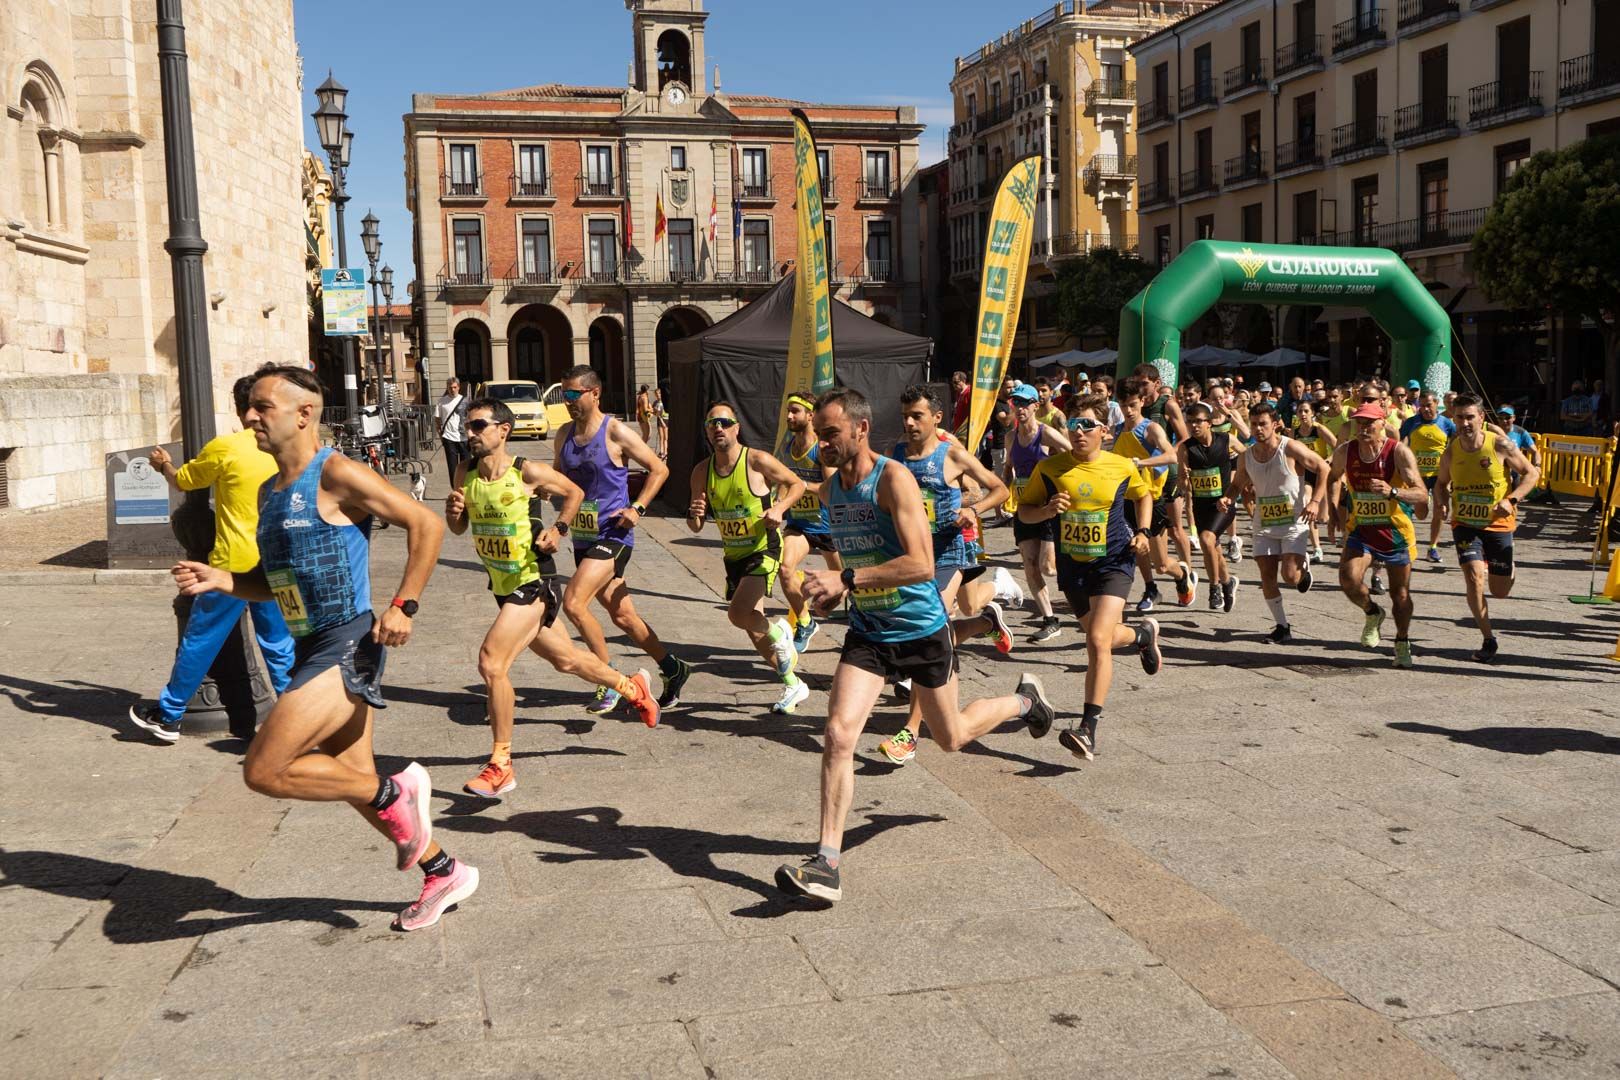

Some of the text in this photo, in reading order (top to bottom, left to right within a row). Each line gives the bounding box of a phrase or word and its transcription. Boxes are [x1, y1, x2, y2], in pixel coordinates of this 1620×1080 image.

[1242, 280, 1376, 295] LEÓN OURENSE VALLADOLID ZAMORA
[1417, 457, 1437, 466] 2438
[1194, 477, 1218, 489] 2446
[1262, 503, 1289, 518] 2434
[1357, 502, 1386, 515] 2380
[1458, 504, 1489, 518] 2400
[720, 520, 749, 537] 2421
[1064, 524, 1101, 543] 2436
[478, 538, 511, 558] 2414
